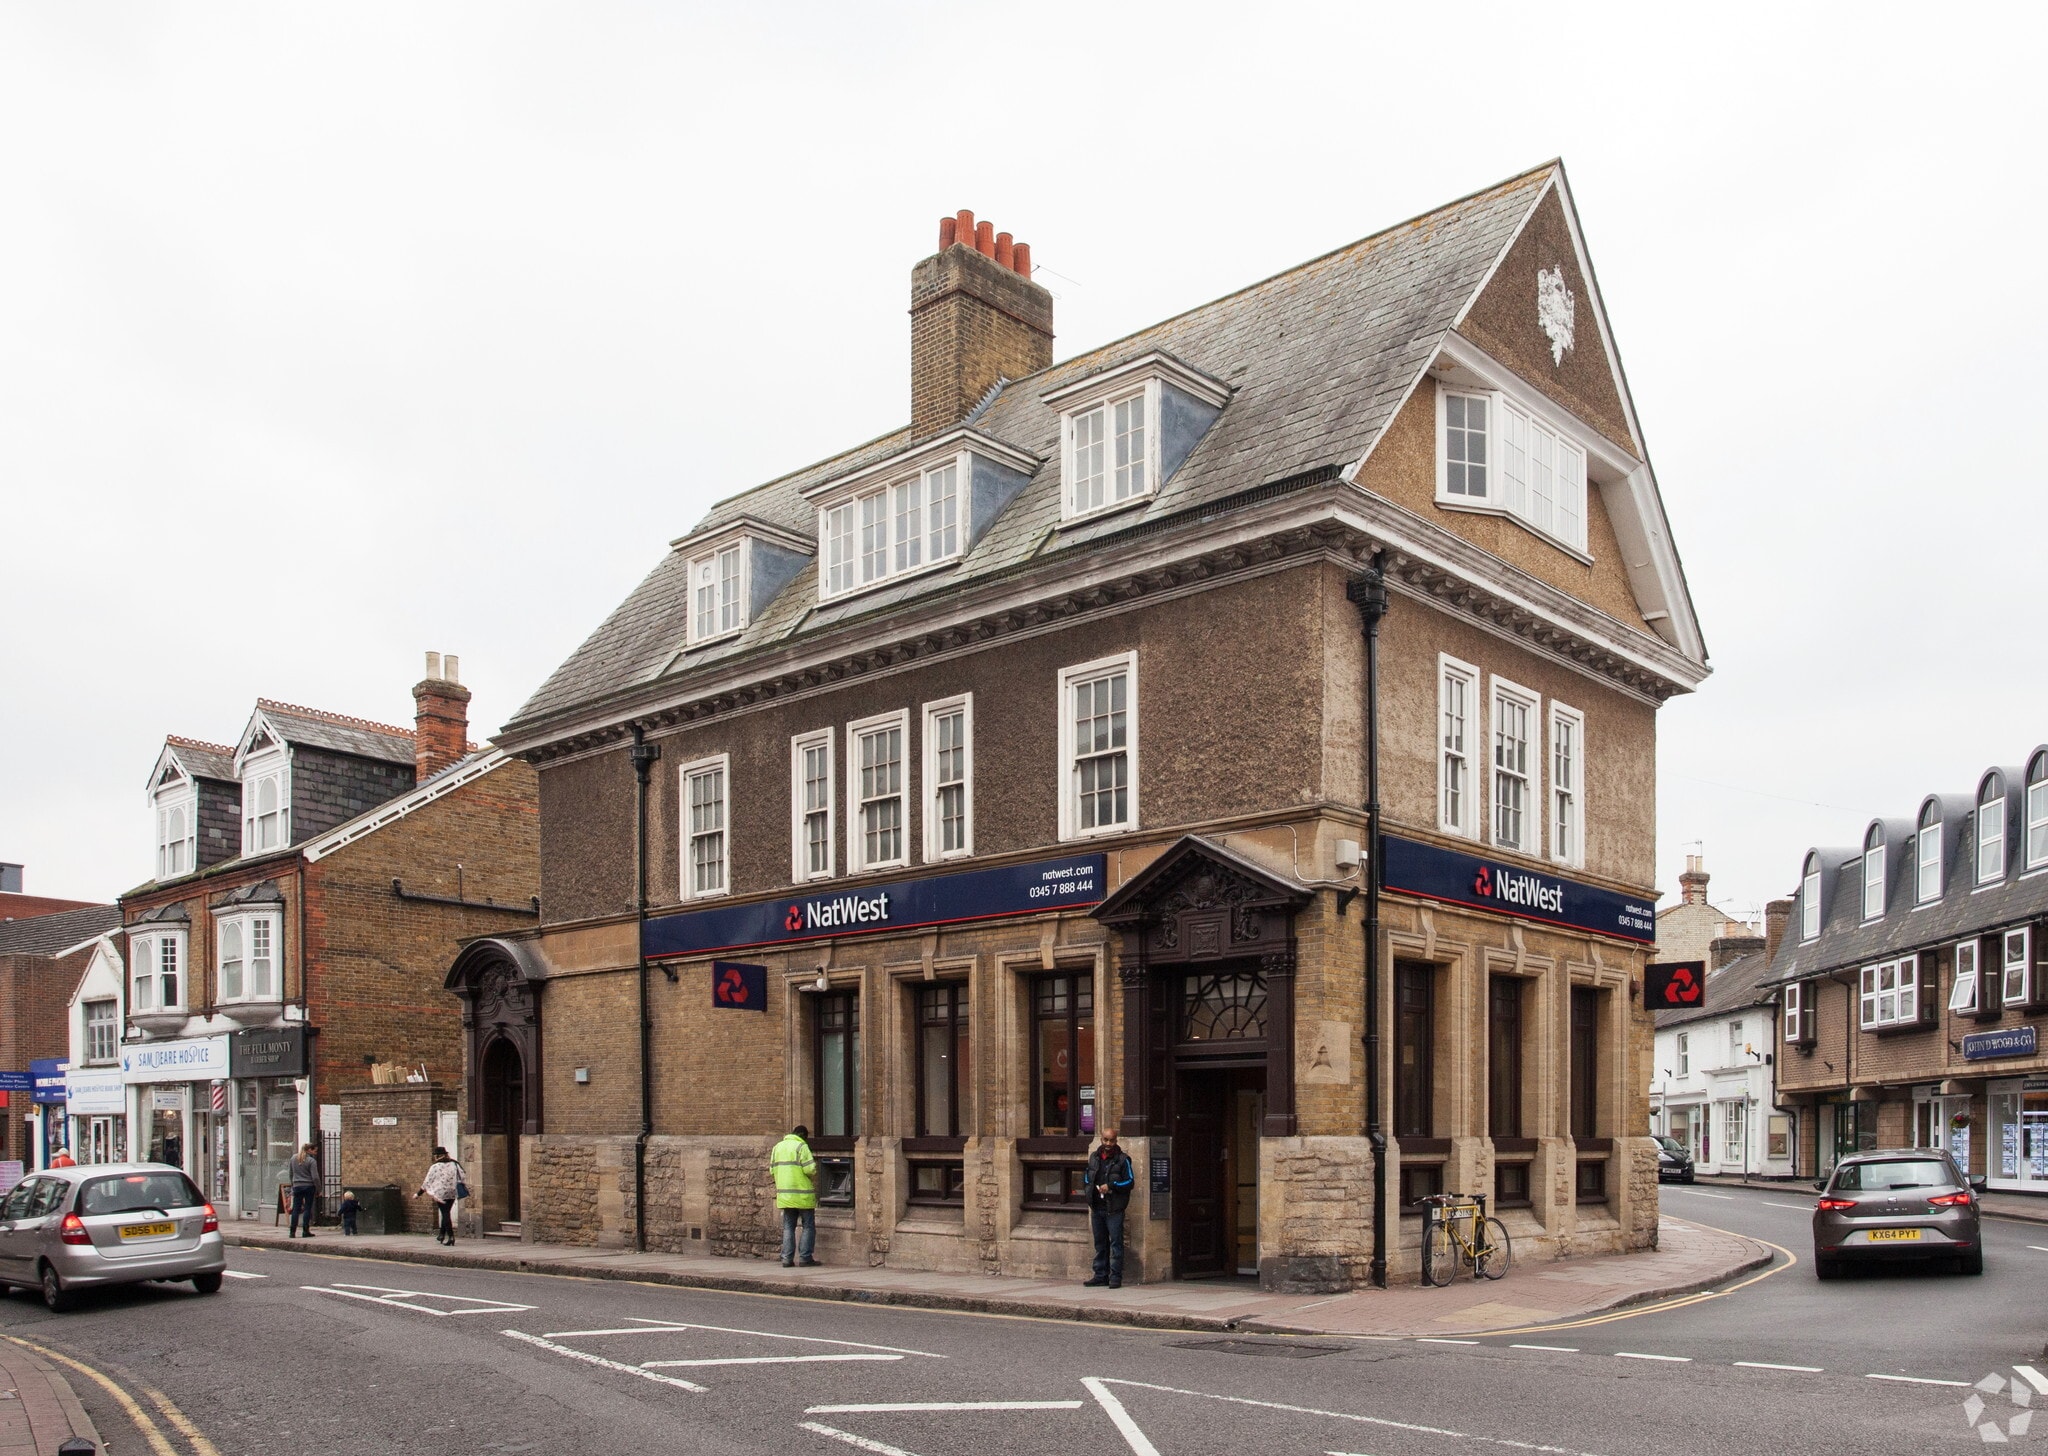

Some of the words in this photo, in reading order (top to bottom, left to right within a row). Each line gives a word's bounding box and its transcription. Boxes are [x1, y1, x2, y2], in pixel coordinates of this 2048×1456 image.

[1043, 866, 1093, 880] natwest.com
[1030, 885, 1050, 898] 0345
[1052, 884, 1058, 895] 7
[1059, 882, 1075, 894] 888
[1077, 880, 1093, 891] 444
[1496, 870, 1563, 913] NatWest
[807, 893, 888, 928] NatWest
[1625, 904, 1652, 917] natwest.com
[1618, 915, 1630, 926] 0345
[1631, 917, 1634, 926] 7
[1634, 918, 1643, 929] 888
[1644, 920, 1652, 931] 444
[239, 1044, 251, 1055] THE
[252, 1043, 268, 1055] FULL
[268, 1041, 291, 1053] MONTY
[1966, 1041, 1985, 1055] JOHN
[1985, 1039, 1991, 1050] D
[1991, 1037, 2013, 1049] WOOD
[2013, 1036, 2020, 1047] &
[2021, 1034, 2031, 1046] CO
[138, 1052, 152, 1067] SAM
[179, 1046, 209, 1064] HOSPICE
[1872, 1231, 1897, 1240] KX64
[1899, 1230, 1918, 1239] PYT
